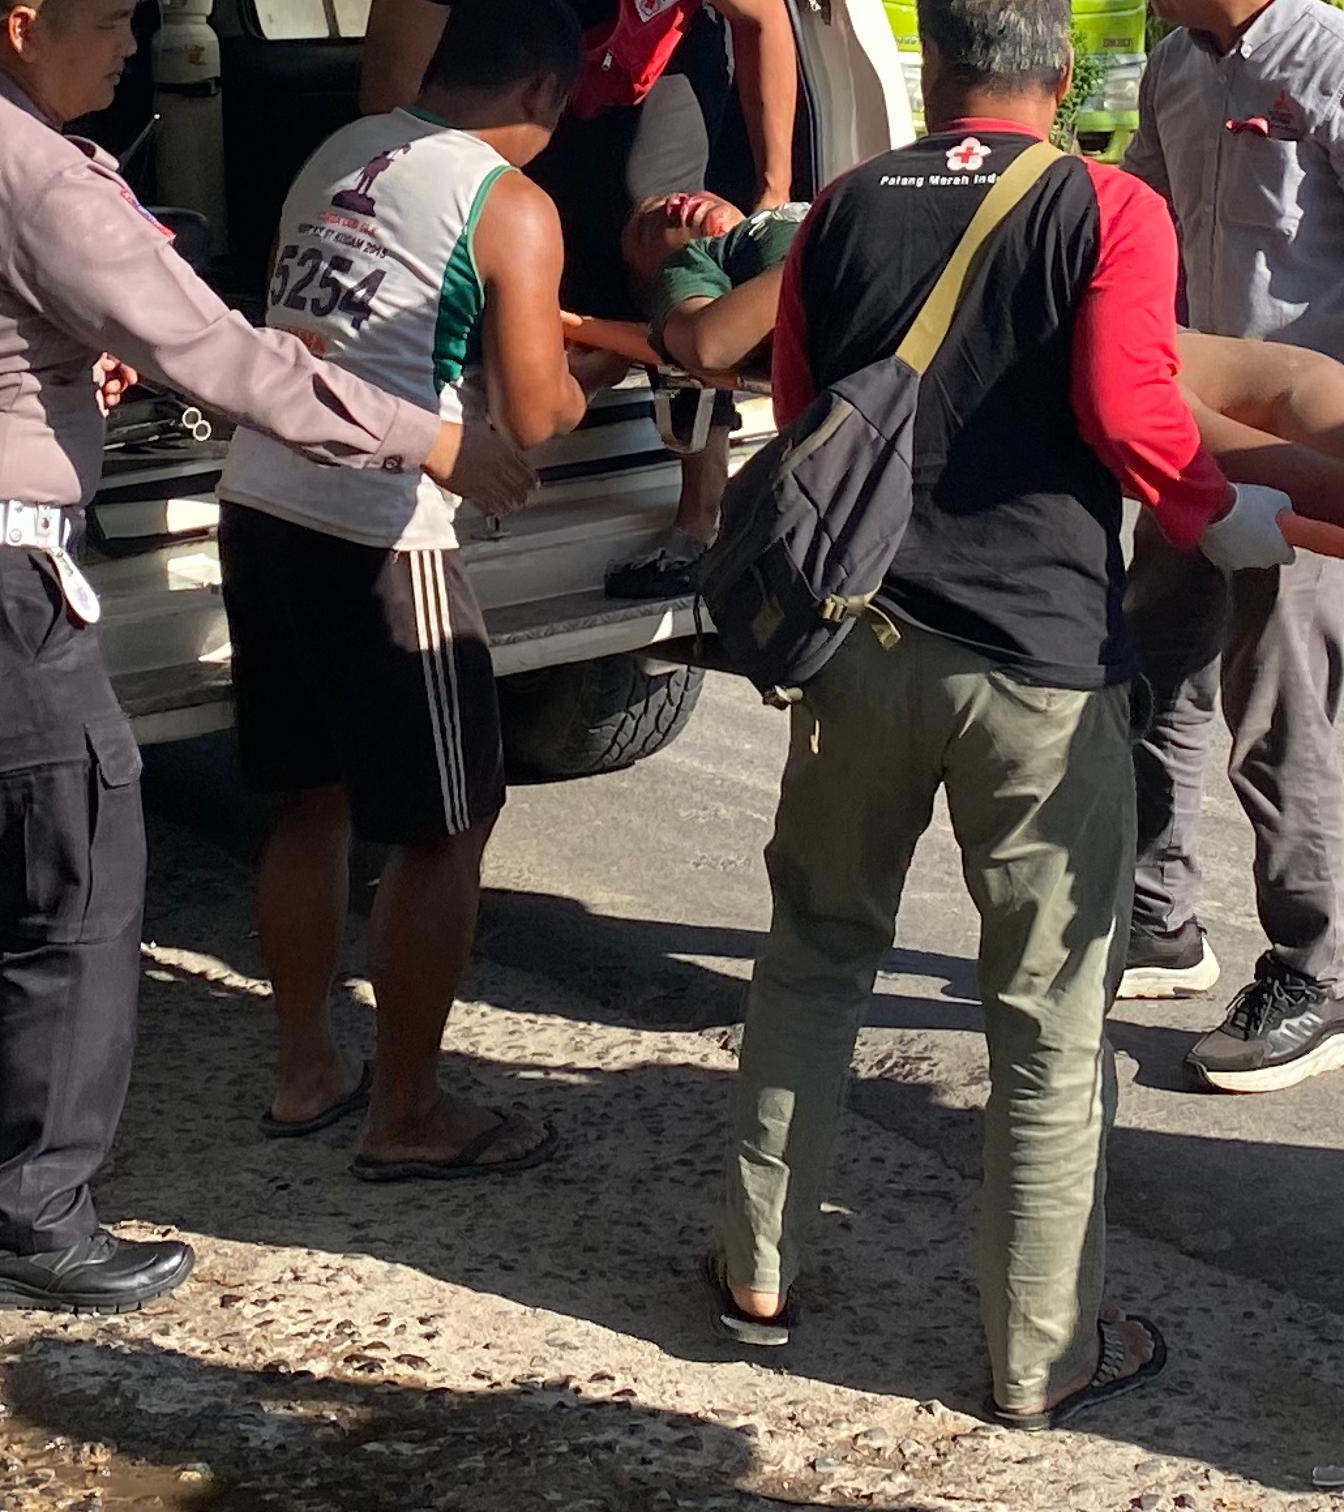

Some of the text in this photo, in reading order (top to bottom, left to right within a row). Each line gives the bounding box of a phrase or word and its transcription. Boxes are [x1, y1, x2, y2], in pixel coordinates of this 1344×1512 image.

[880, 176, 924, 187] Palang
[929, 175, 970, 185] Merah
[270, 245, 387, 331] 5254
